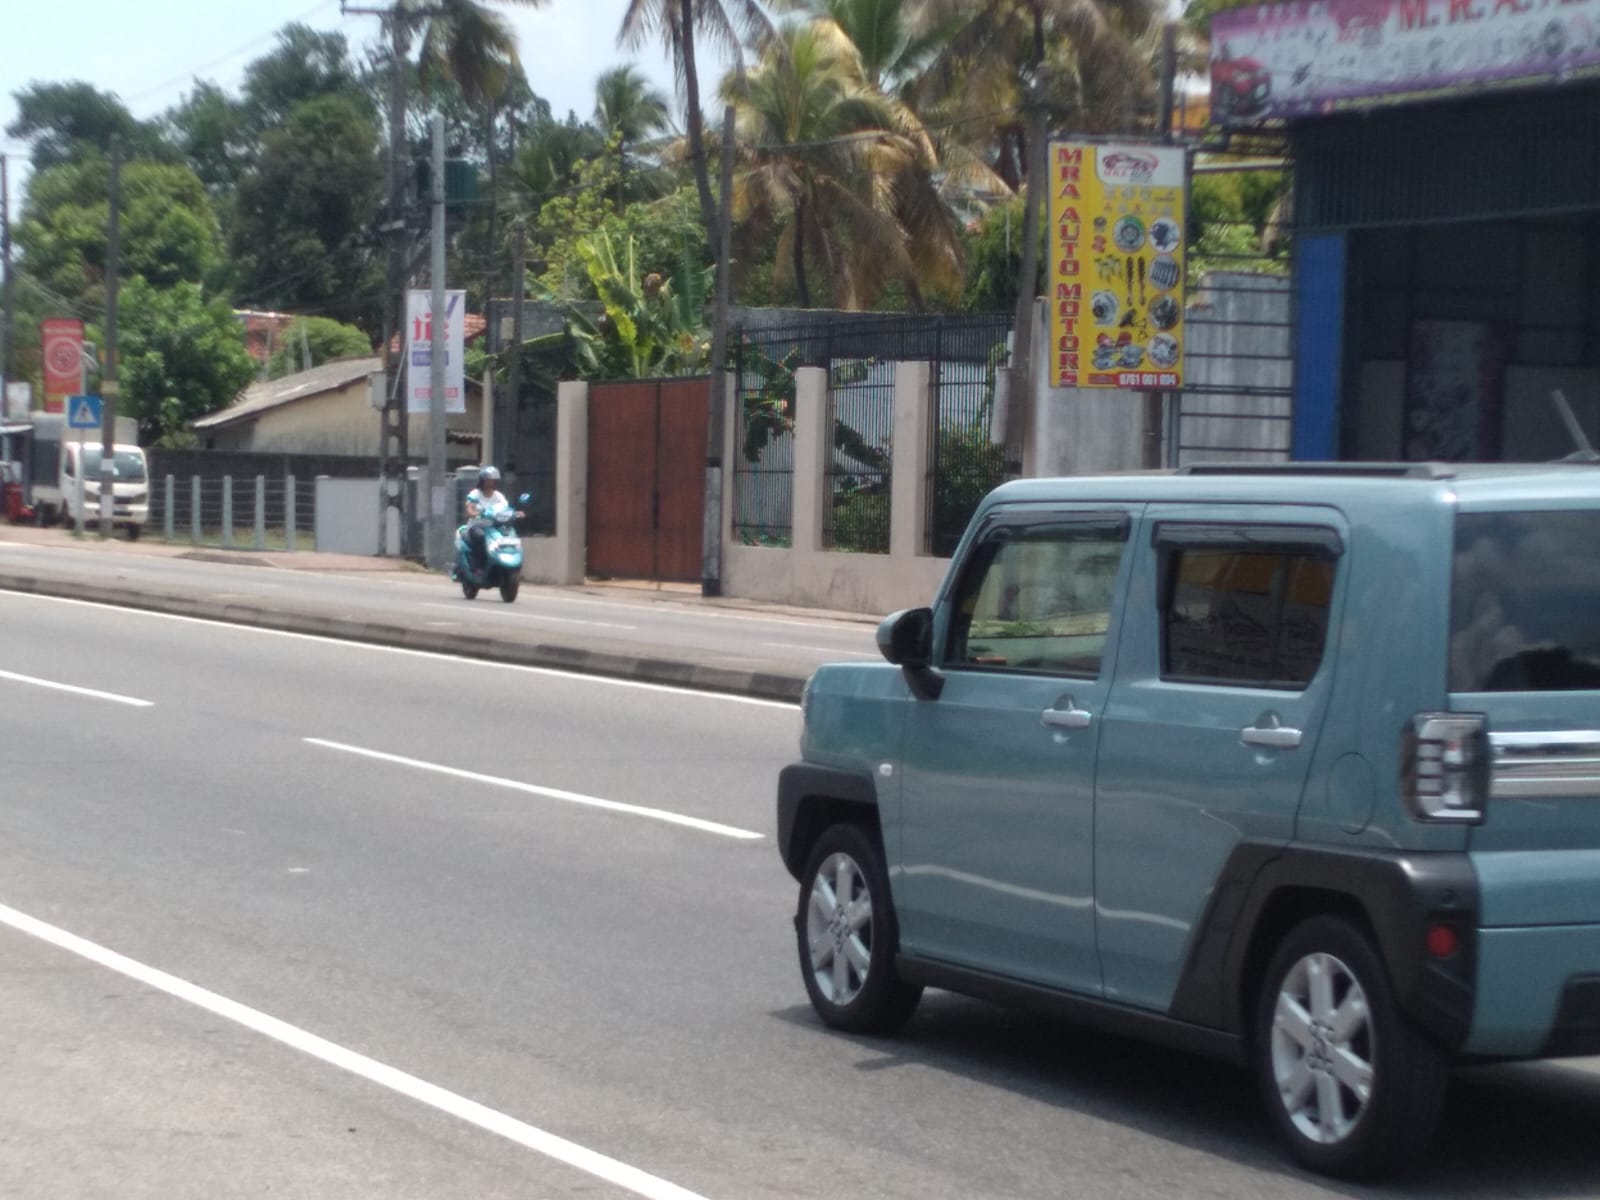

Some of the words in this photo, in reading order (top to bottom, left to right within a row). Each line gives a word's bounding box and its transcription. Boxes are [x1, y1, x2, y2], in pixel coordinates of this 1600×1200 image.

[1057, 148, 1083, 199] MRA
[1058, 206, 1081, 277] AUTO
[1057, 283, 1082, 387] MOTORS
